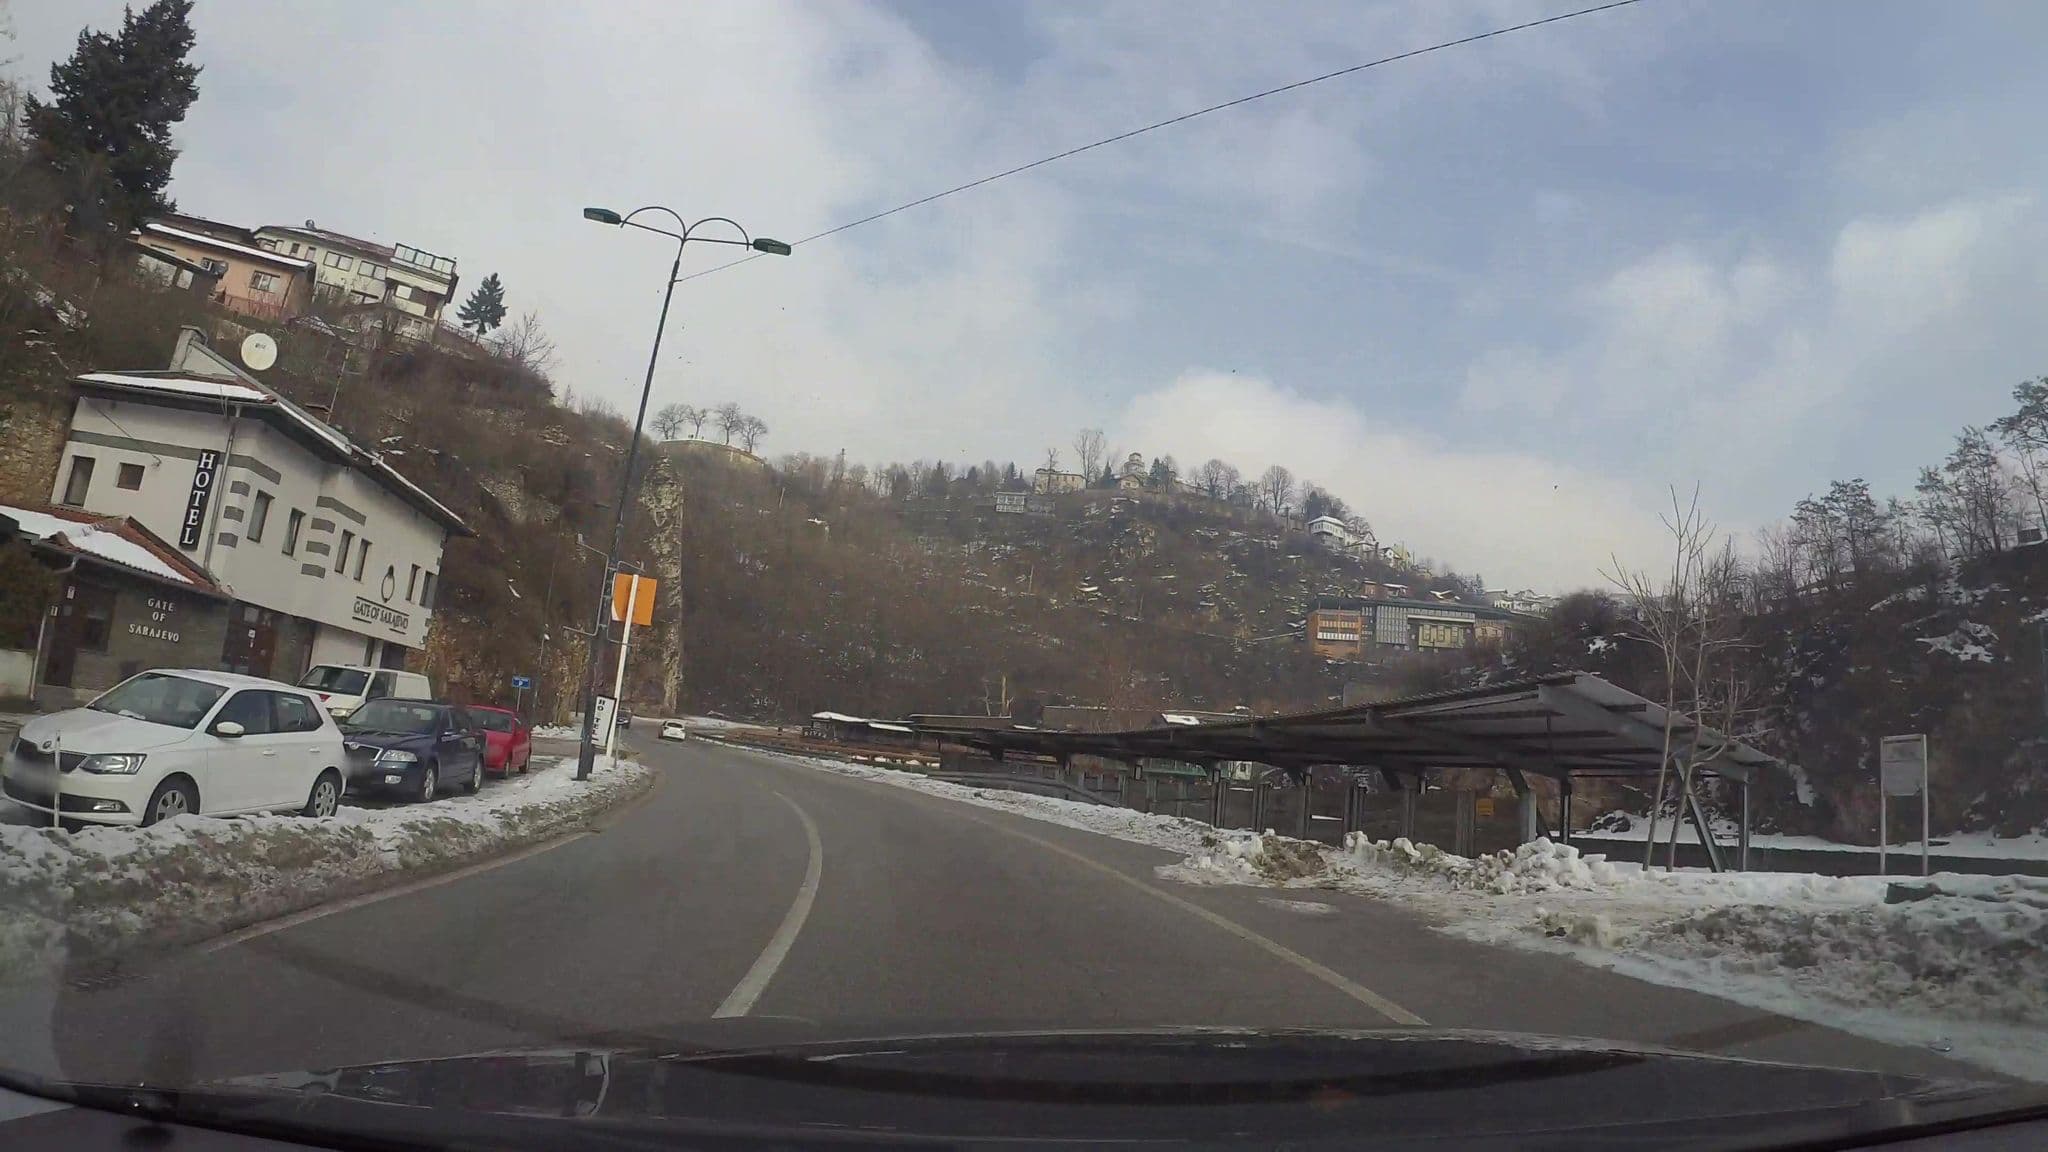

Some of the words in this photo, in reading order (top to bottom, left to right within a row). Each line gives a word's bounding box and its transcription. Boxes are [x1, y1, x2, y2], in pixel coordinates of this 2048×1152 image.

[182, 452, 216, 545] HOTEL
[147, 598, 175, 612] GATE
[353, 600, 371, 617] GATE
[371, 606, 380, 620] OF
[152, 611, 166, 622] OF
[128, 623, 180, 642] SARAJEVO
